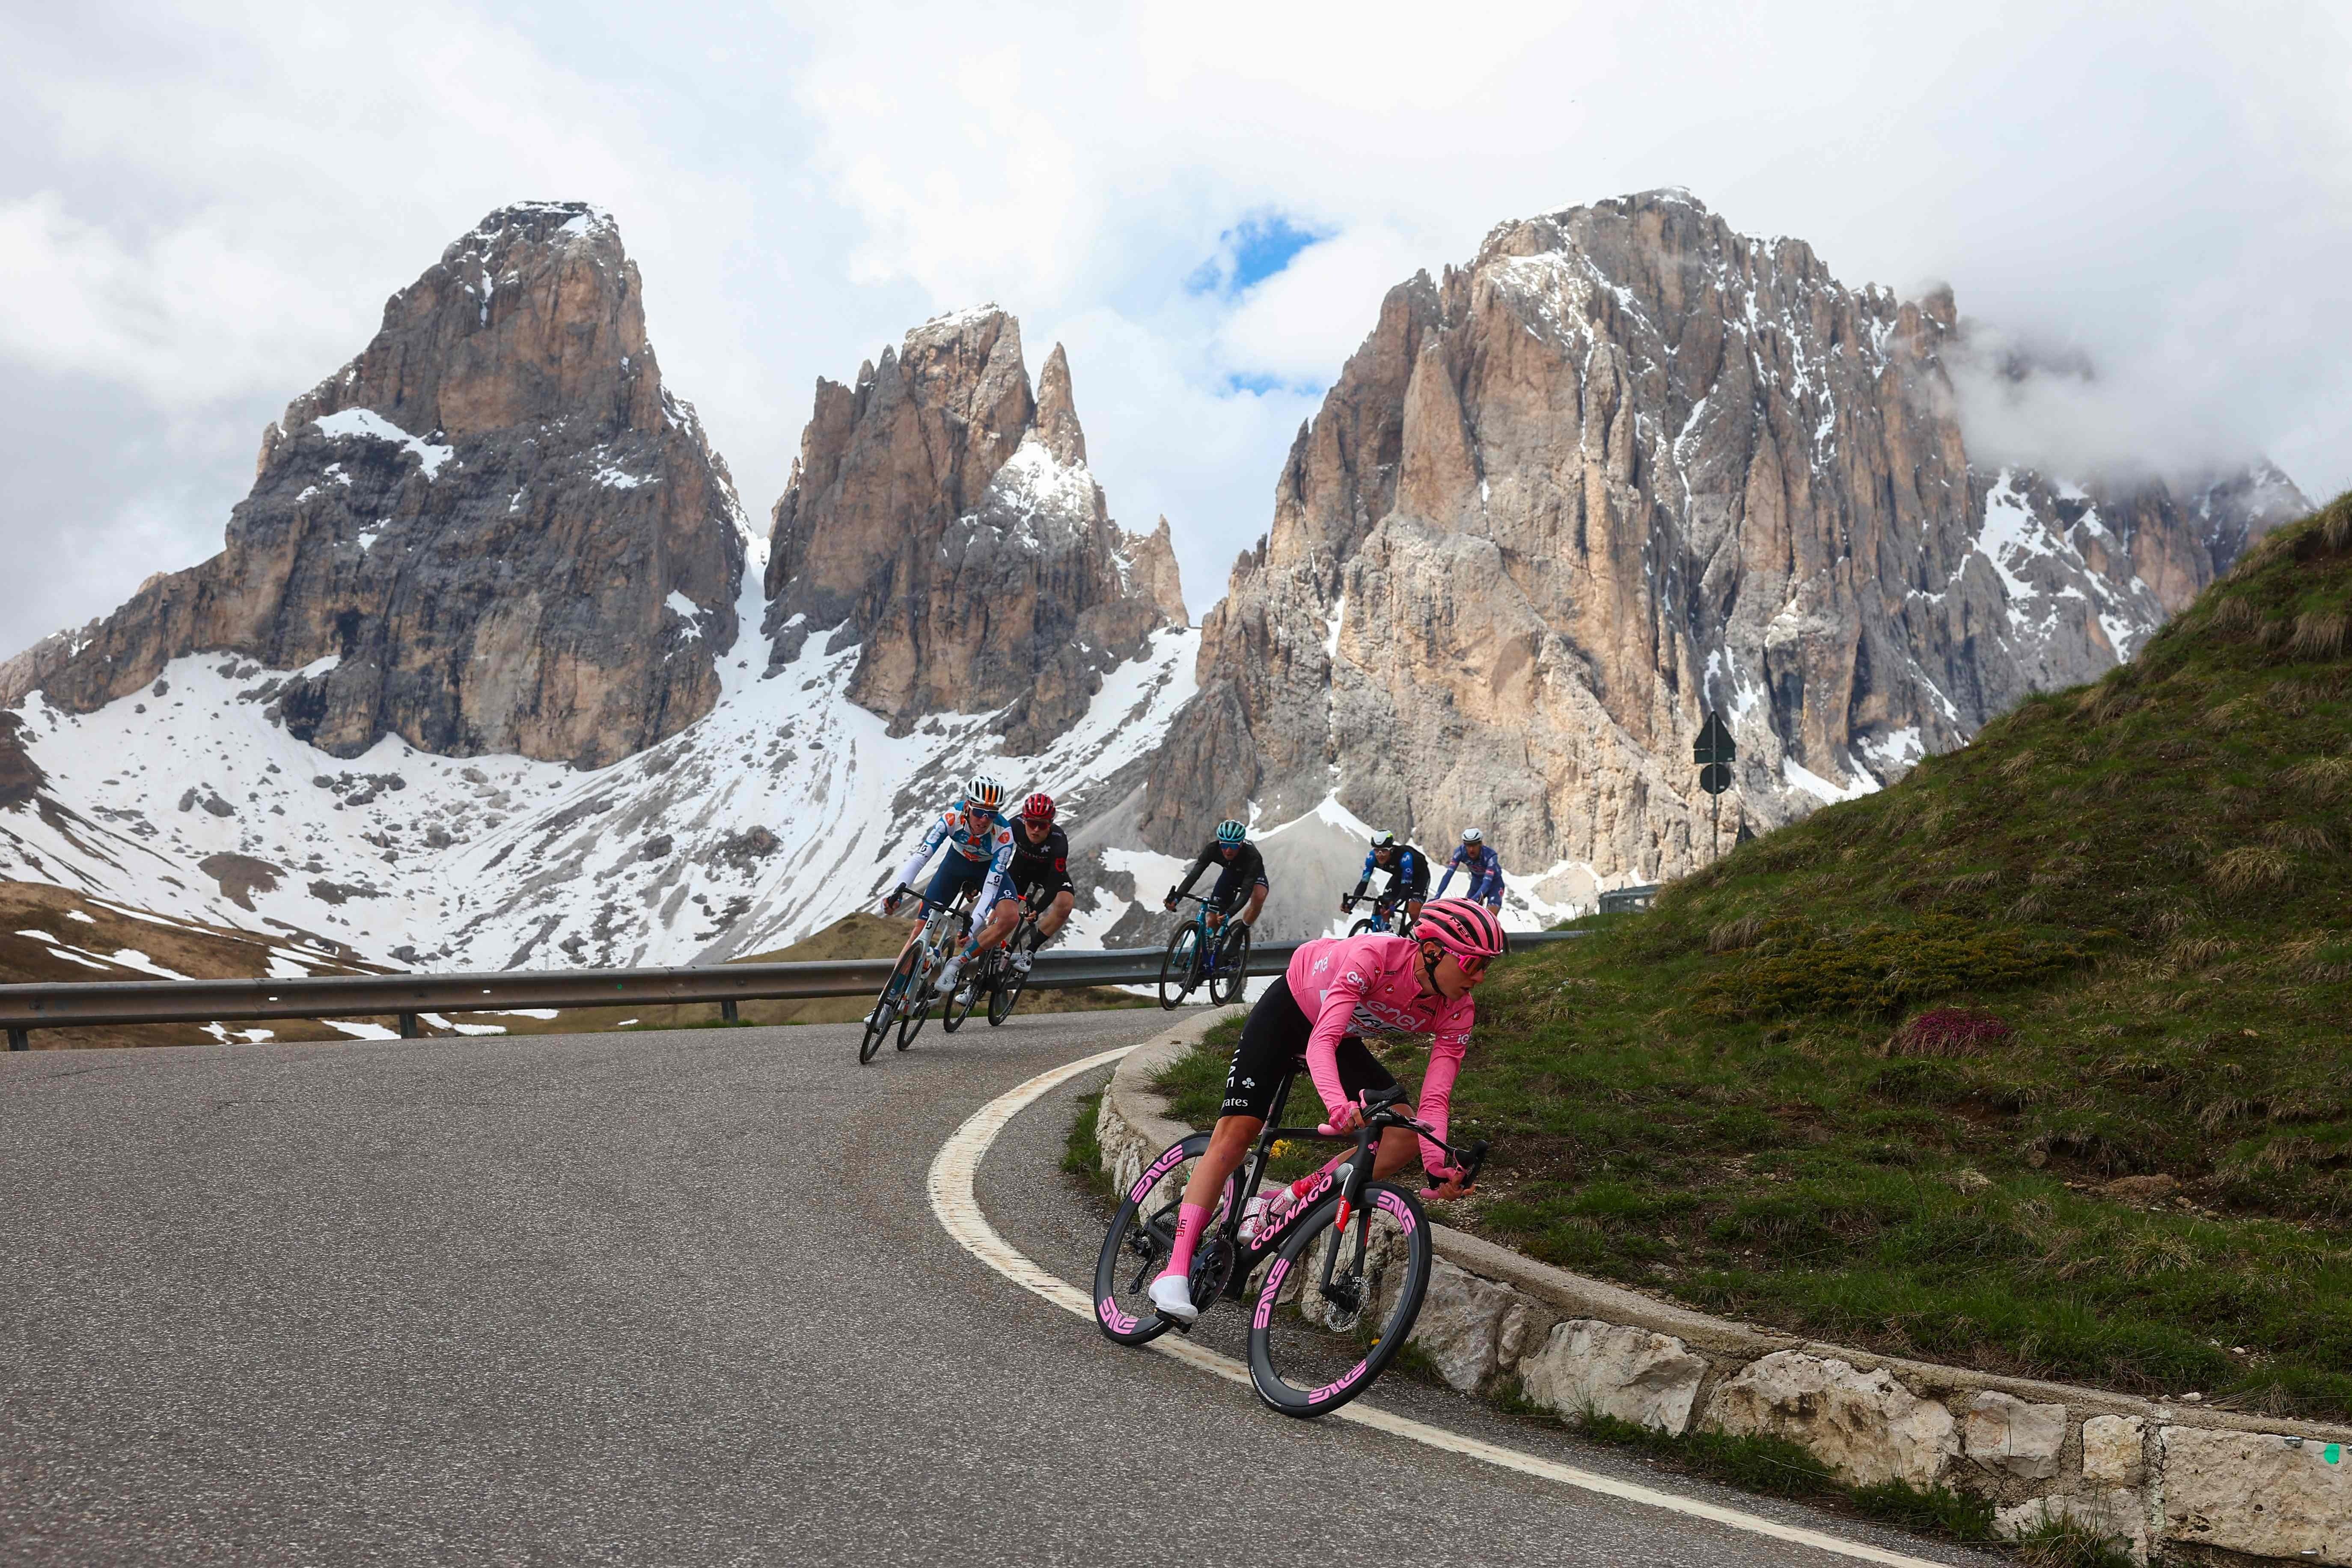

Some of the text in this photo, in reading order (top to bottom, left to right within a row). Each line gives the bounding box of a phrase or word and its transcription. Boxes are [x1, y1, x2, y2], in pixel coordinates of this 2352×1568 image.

[1367, 1000, 1427, 1031] enel
[1251, 1175, 1332, 1250] COLNAGO
[1335, 1200, 1346, 1224] Emirates
